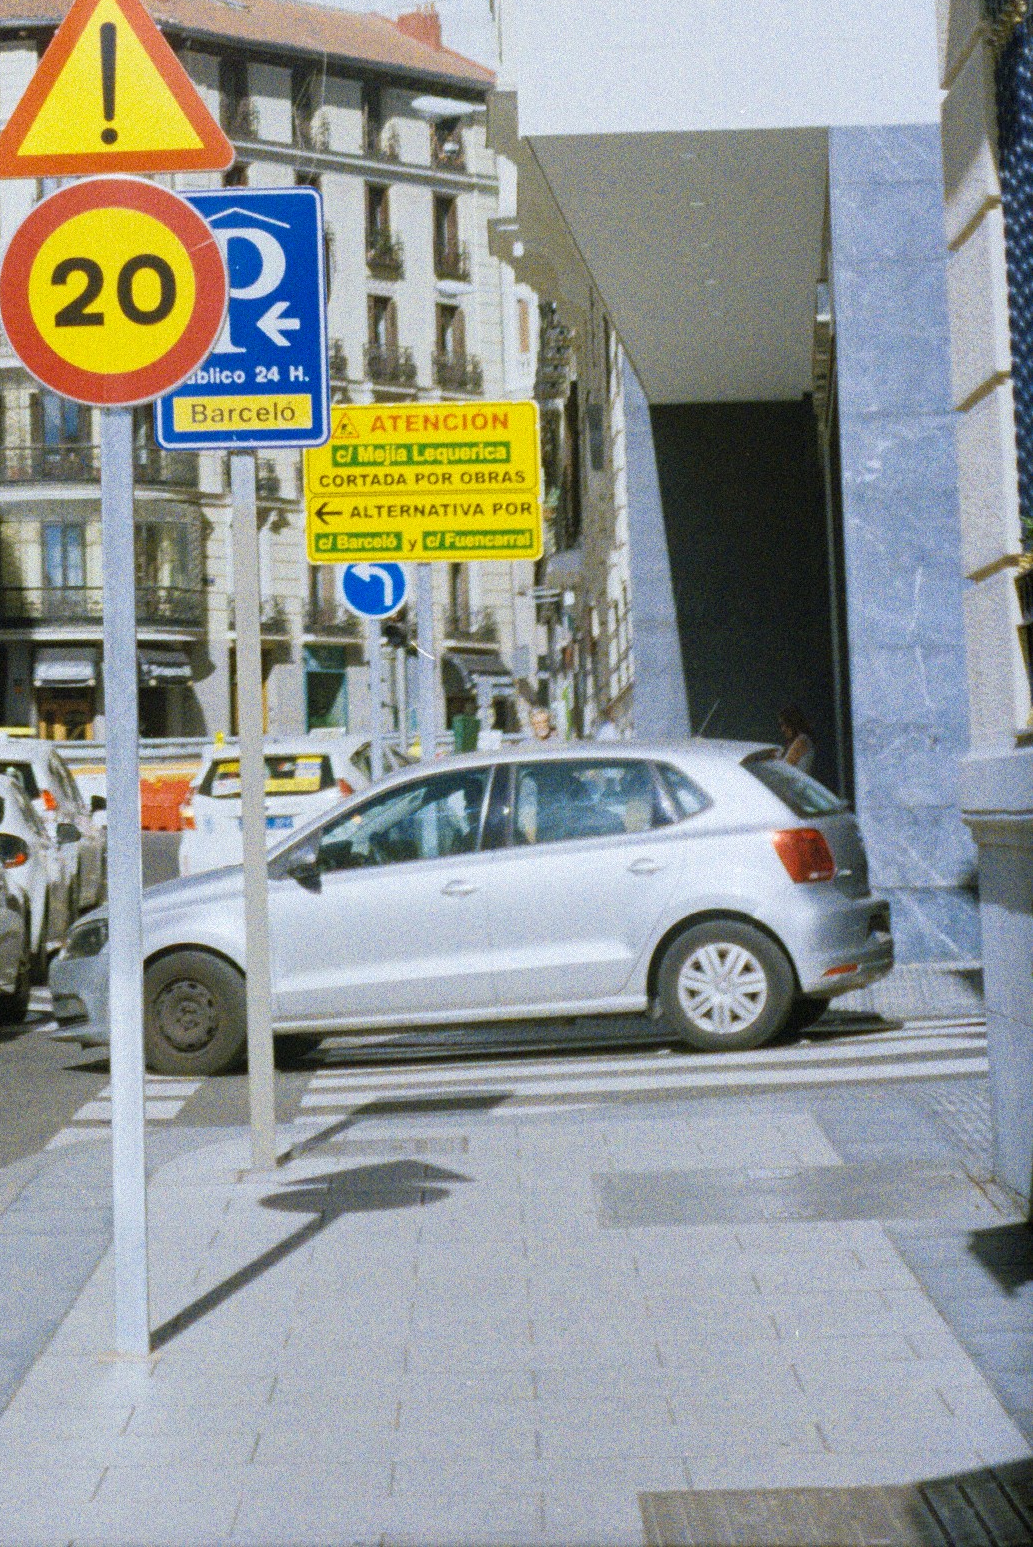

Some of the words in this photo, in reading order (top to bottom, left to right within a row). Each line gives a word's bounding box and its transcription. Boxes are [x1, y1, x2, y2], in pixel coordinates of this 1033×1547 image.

[50, 253, 177, 328] 20
[254, 365, 281, 383] 24
[289, 364, 310, 382] H.
[190, 402, 296, 424] Barceló
[370, 409, 509, 433] ATENCIÓN
[335, 447, 353, 463] c/
[412, 444, 508, 464] Lequerica
[319, 473, 408, 488] CORTADA
[414, 471, 453, 486] POR
[459, 470, 526, 485] OBRAS
[349, 502, 485, 518] ALTERNATIVA
[492, 501, 533, 516] POR
[318, 534, 334, 550] c/
[336, 532, 398, 550] Barceló
[407, 538, 418, 552] y
[425, 532, 442, 548] c/
[444, 531, 531, 548] Fuencarral
